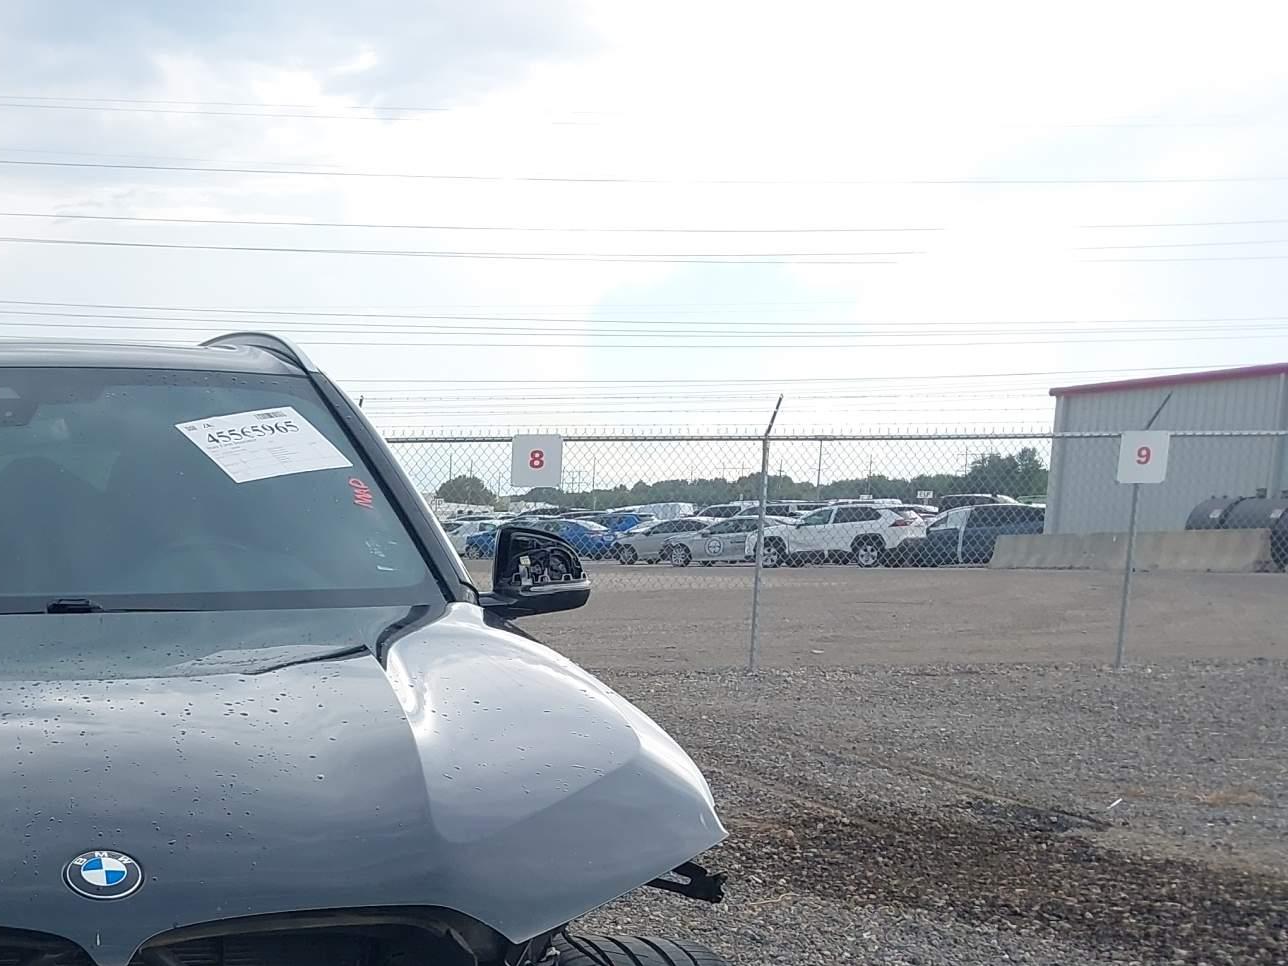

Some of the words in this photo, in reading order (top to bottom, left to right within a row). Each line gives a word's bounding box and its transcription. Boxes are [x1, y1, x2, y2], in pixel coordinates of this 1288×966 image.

[207, 420, 300, 444] 45565965
[529, 449, 544, 469] 8
[1135, 446, 1151, 465] 9
[72, 851, 133, 866] BMW
